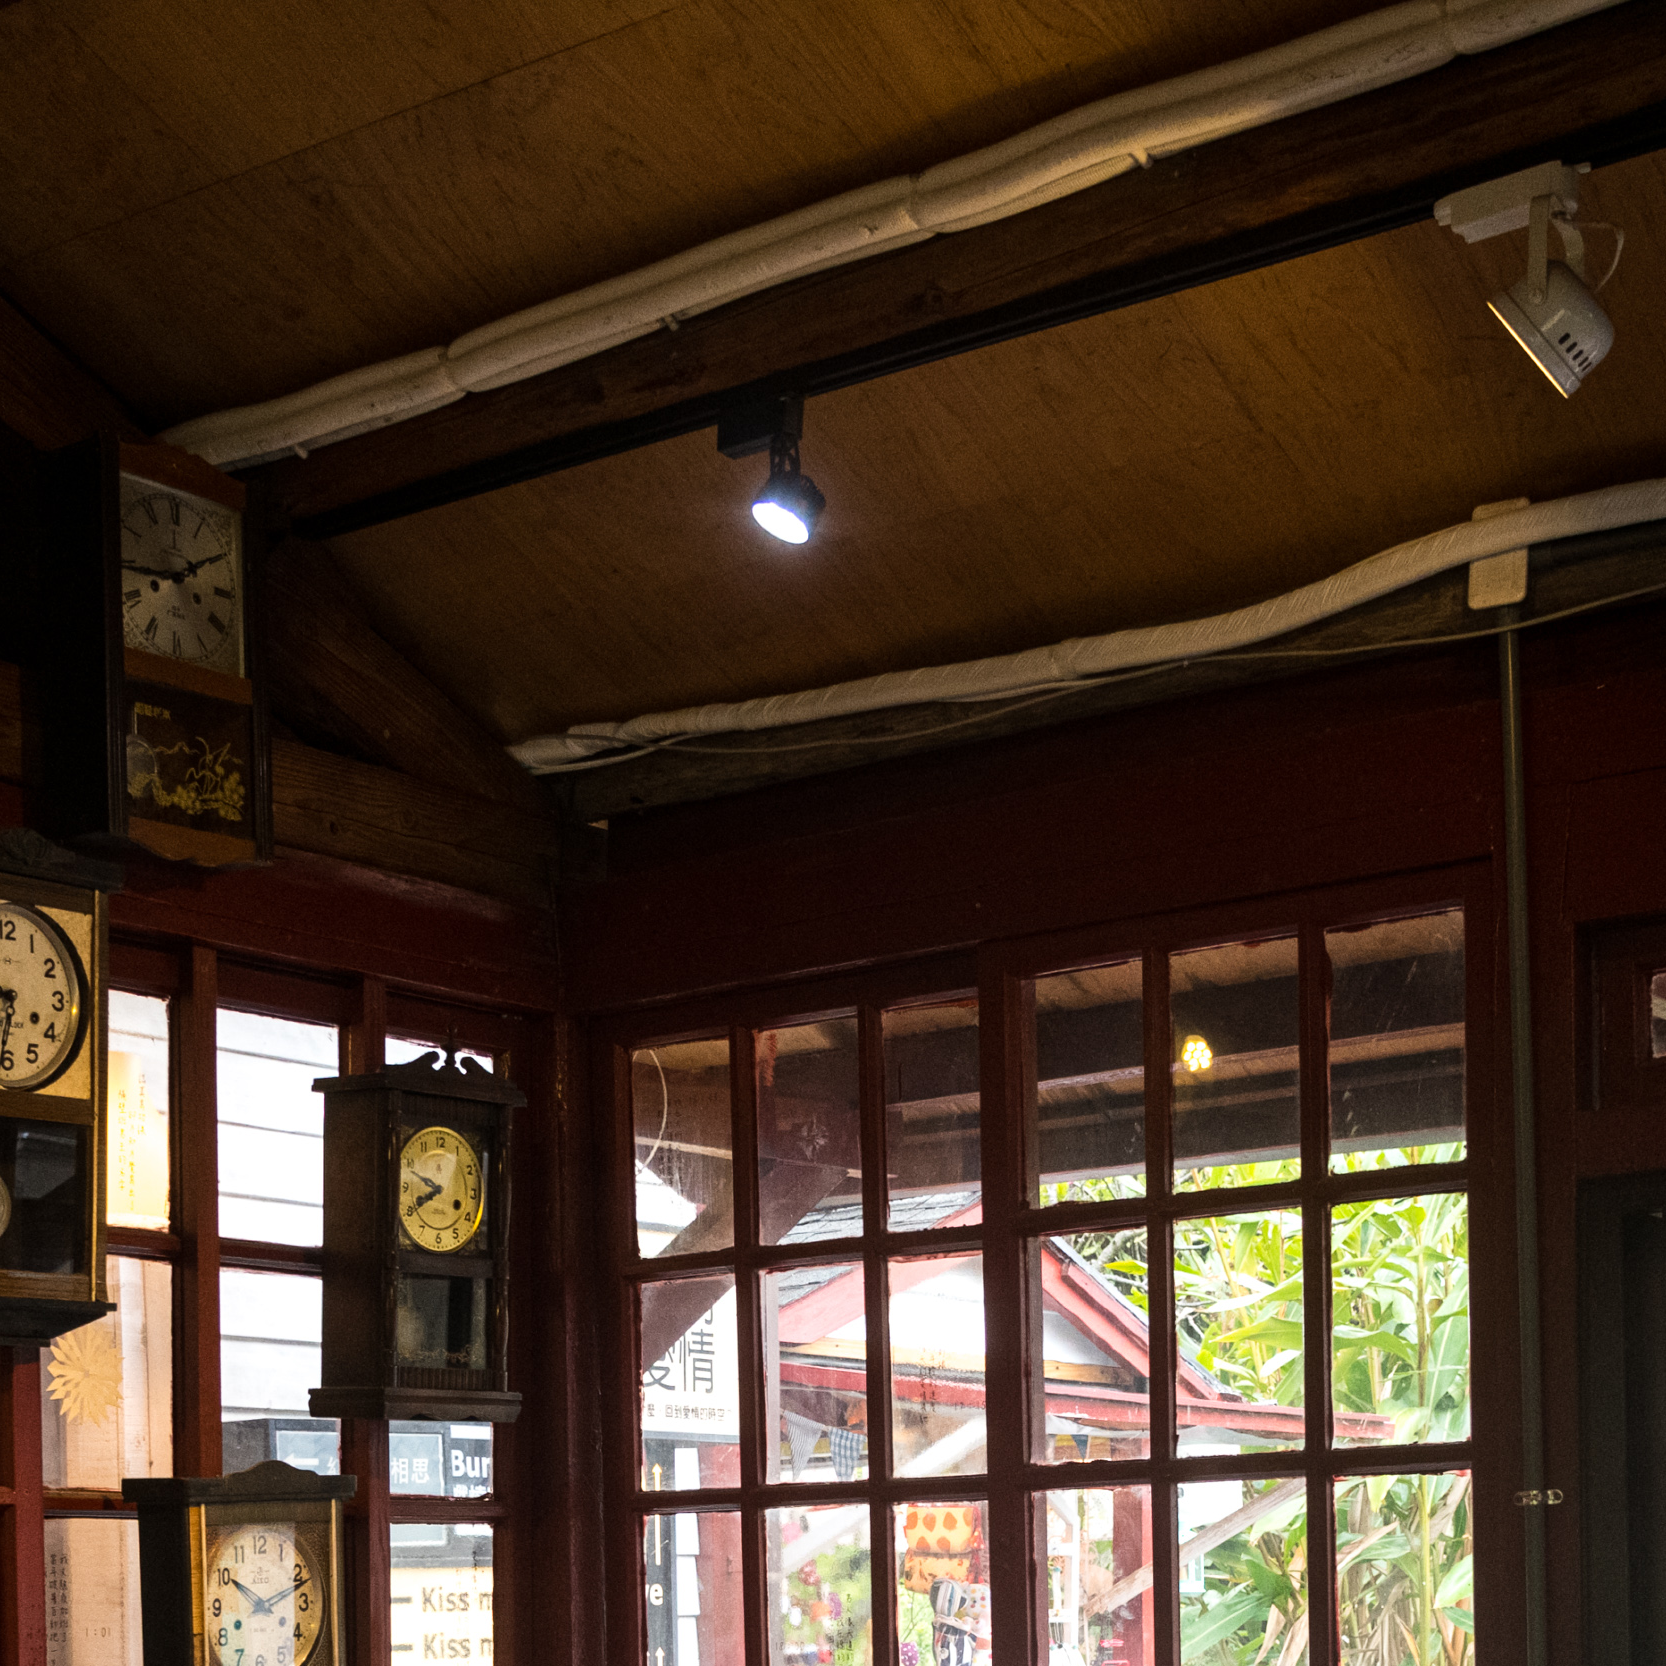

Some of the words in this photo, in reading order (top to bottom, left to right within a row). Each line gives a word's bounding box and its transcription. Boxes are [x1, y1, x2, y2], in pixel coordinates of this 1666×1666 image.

[0, 920, 16, 941] 12
[44, 958, 56, 978] 2
[52, 991, 64, 1011] 3
[44, 1022, 56, 1042] 4
[1, 1050, 14, 1070] 6
[26, 1043, 38, 1063] 5
[420, 1141, 427, 1153] 11
[436, 1137, 445, 1148] 12
[467, 1165, 473, 1176] 2
[402, 1182, 409, 1193] 9
[470, 1188, 477, 1200] 3
[407, 1205, 414, 1217] 8
[464, 1212, 471, 1222] 4
[419, 1225, 425, 1239] 7
[435, 1232, 442, 1244] 6
[453, 1228, 459, 1239] 5
[234, 1545, 245, 1564] 11
[252, 1535, 267, 1555] 12
[218, 1568, 231, 1586] 10
[293, 1563, 303, 1583] 2
[212, 1598, 222, 1617] 9
[299, 1593, 309, 1612] 3
[422, 1587, 469, 1612] Kiss
[218, 1627, 228, 1647] 8
[293, 1622, 303, 1641] 4
[277, 1645, 286, 1664] 5
[424, 1634, 471, 1659] Kiss
